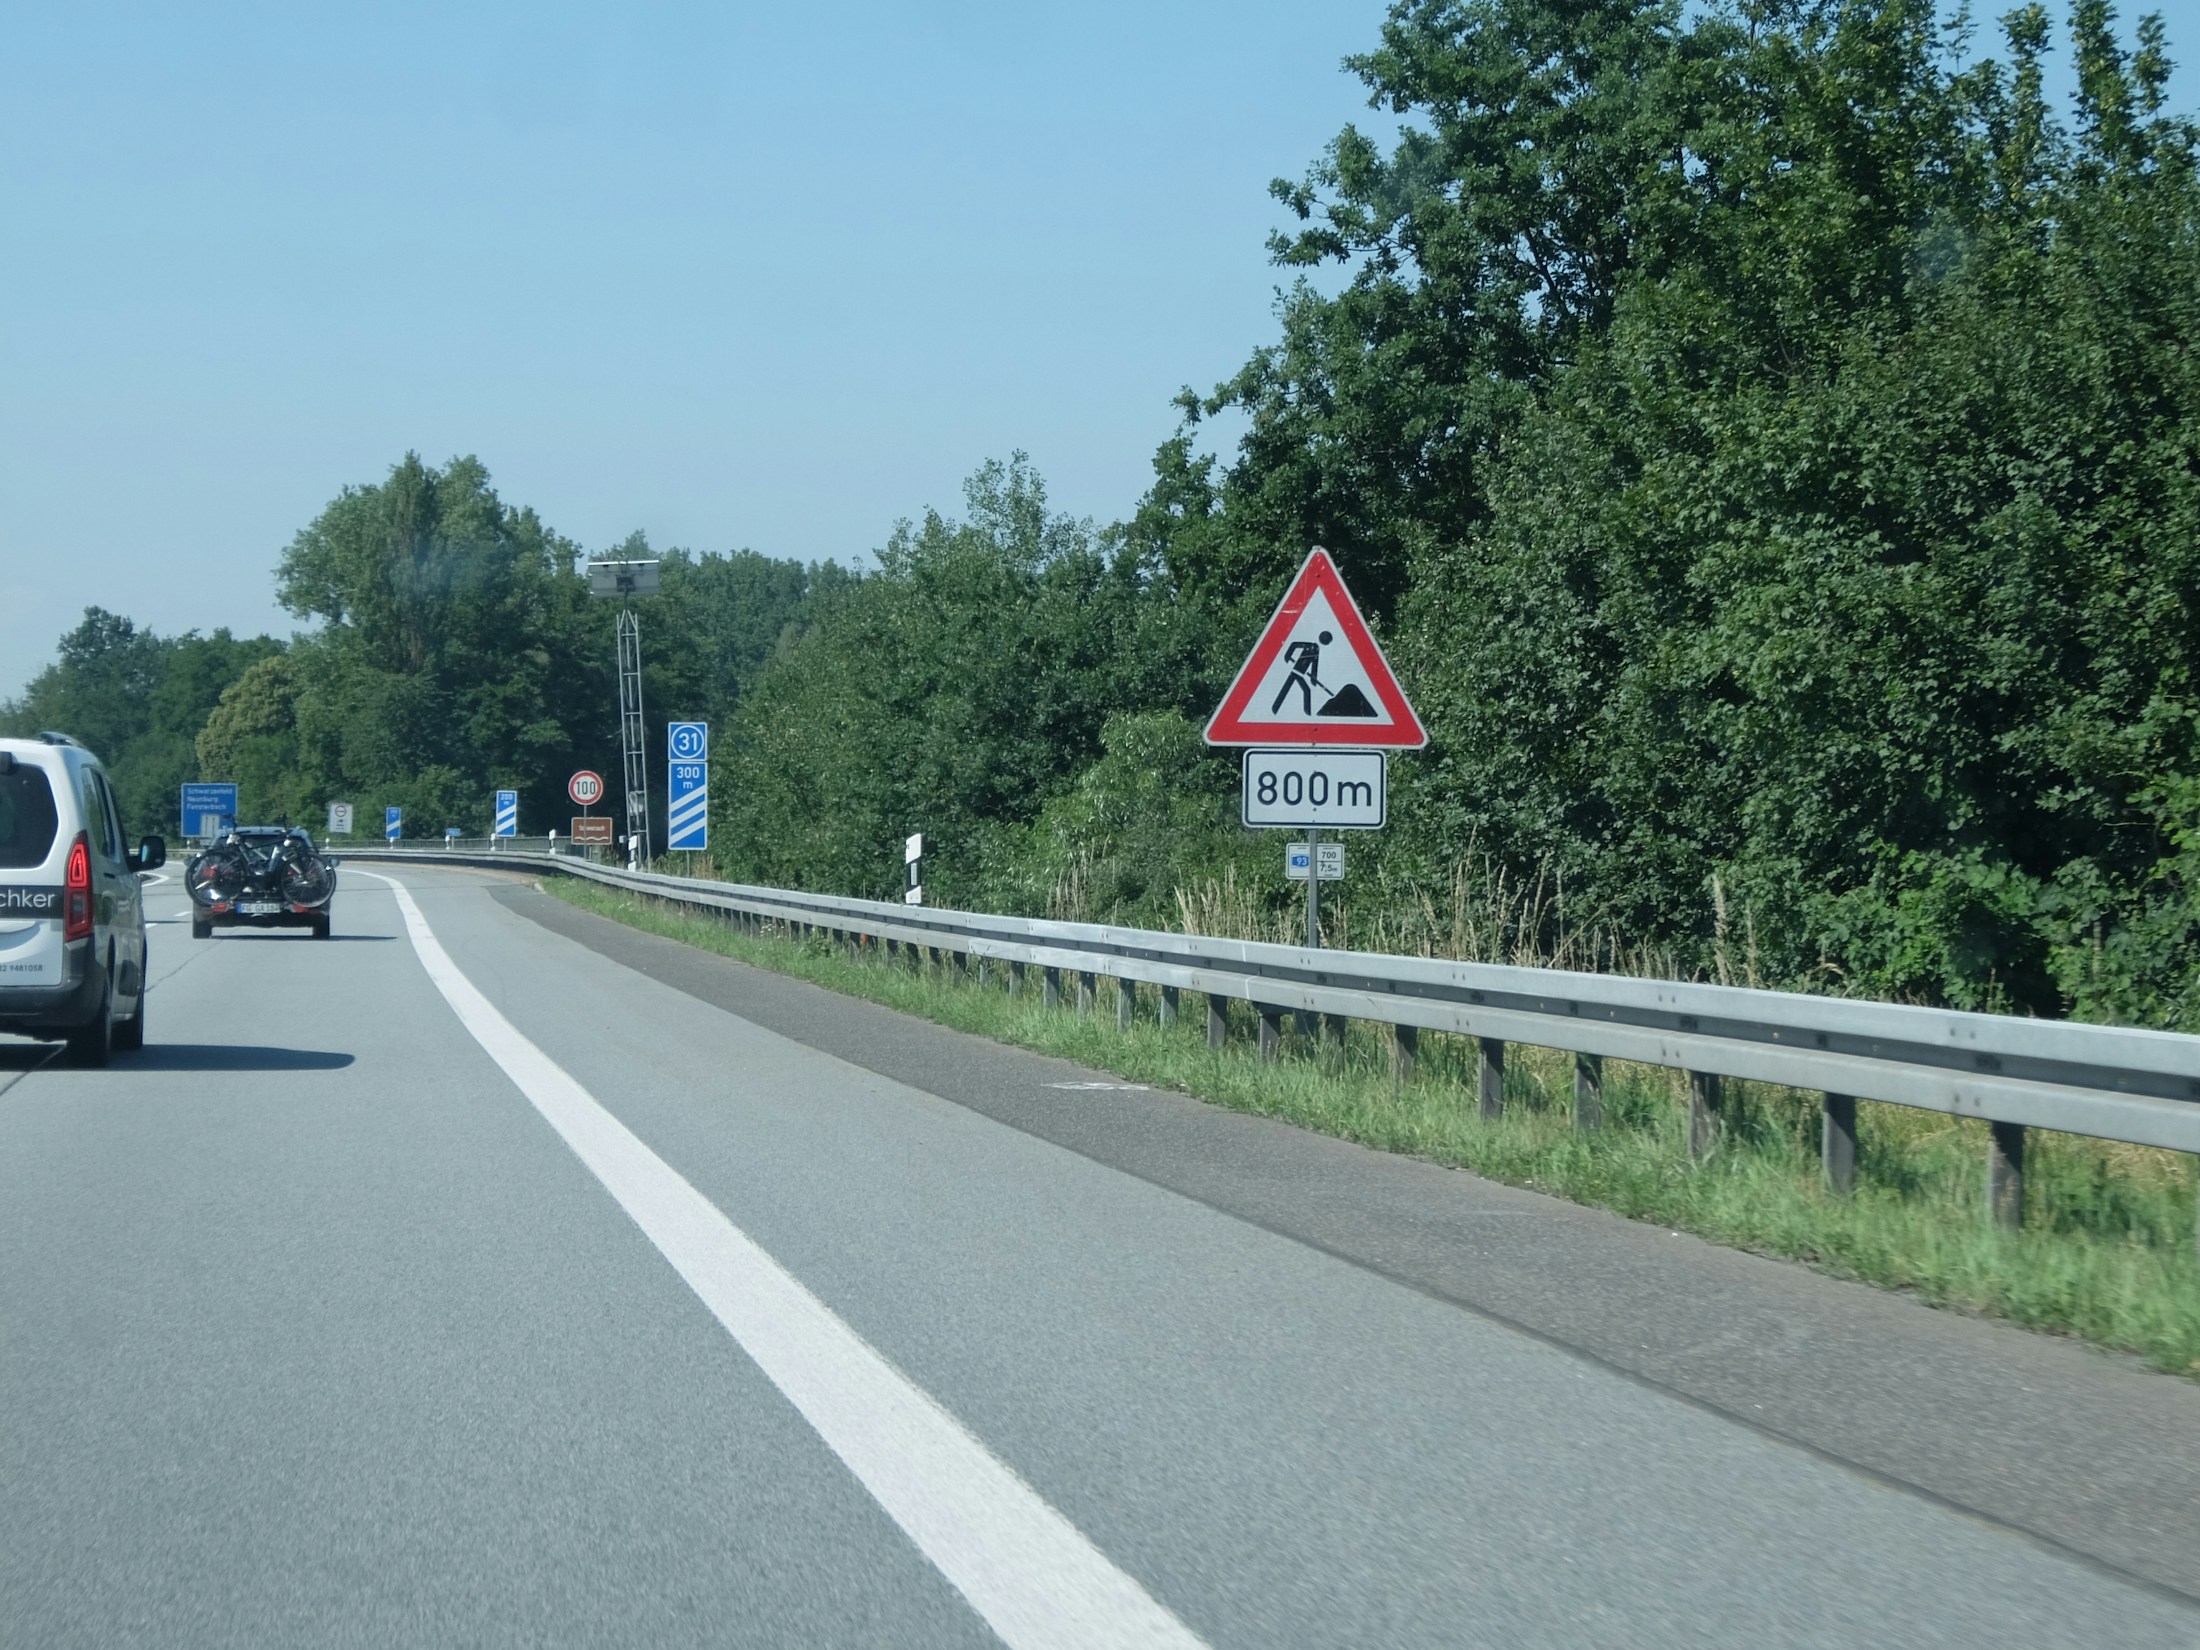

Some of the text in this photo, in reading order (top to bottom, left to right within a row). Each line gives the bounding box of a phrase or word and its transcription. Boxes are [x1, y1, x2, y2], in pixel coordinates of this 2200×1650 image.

[679, 732, 697, 751] 31
[677, 767, 699, 778] 300
[576, 781, 596, 795] 100
[682, 781, 693, 789] m
[1257, 770, 1372, 807] 800 m
[500, 793, 513, 801] 200
[1321, 851, 1337, 859] 700
[1296, 856, 1308, 866] 93
